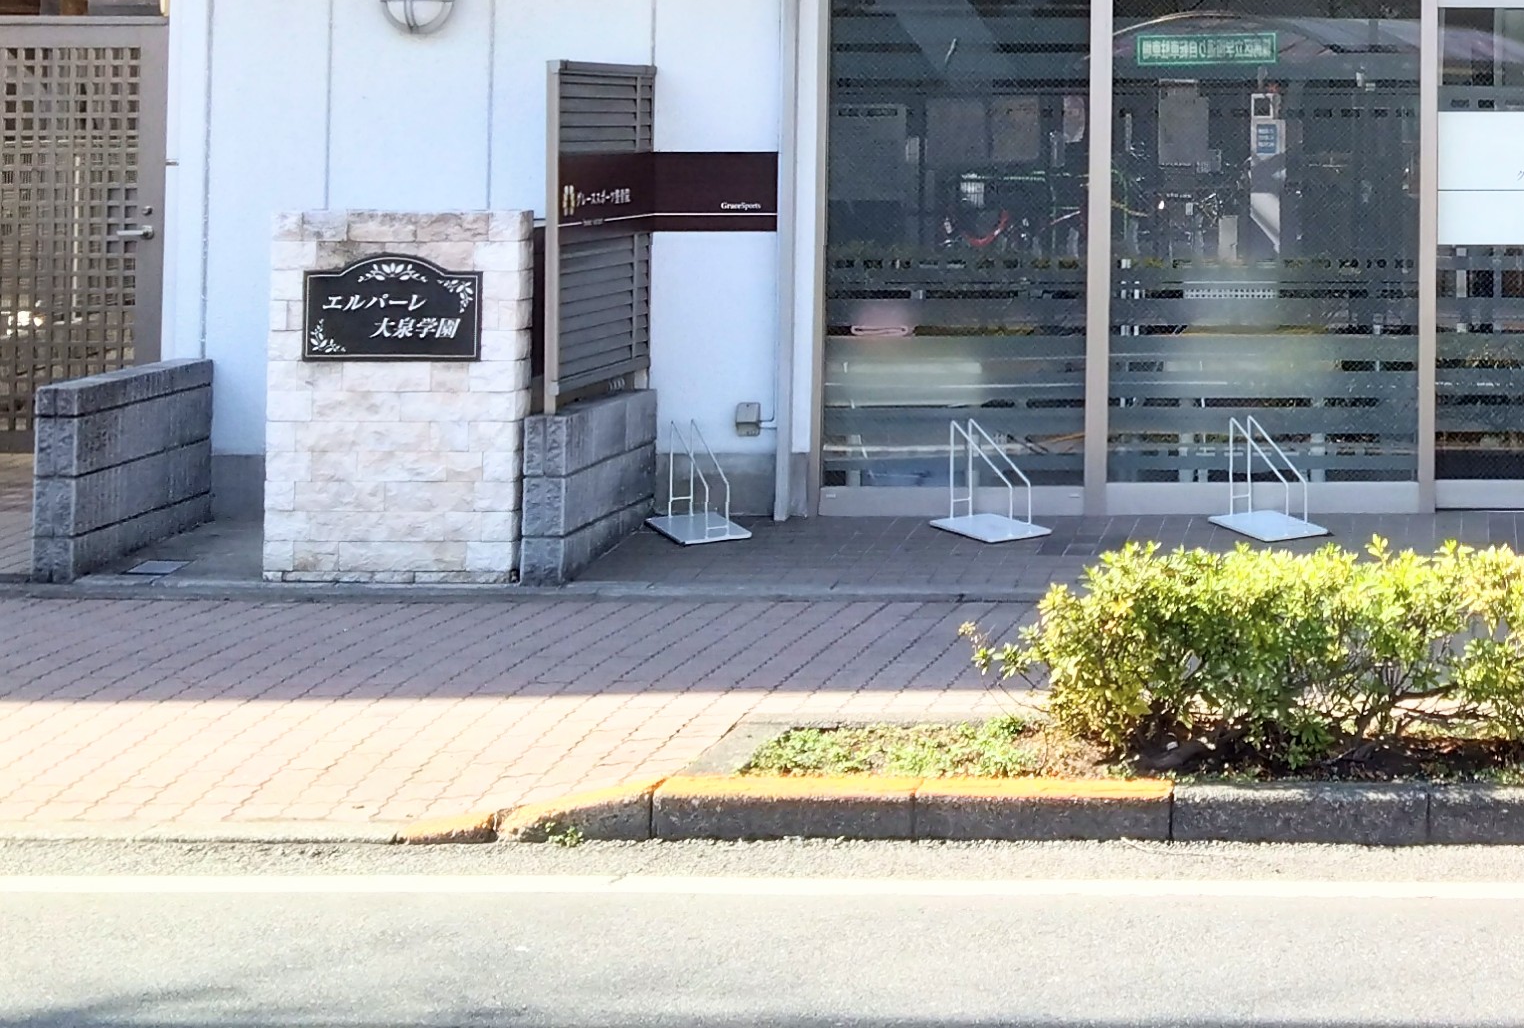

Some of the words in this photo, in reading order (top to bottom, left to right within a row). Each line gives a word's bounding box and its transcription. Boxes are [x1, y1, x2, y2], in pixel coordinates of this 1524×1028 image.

[322, 293, 428, 312] エルパーレ
[368, 317, 462, 339] 大泉学園
